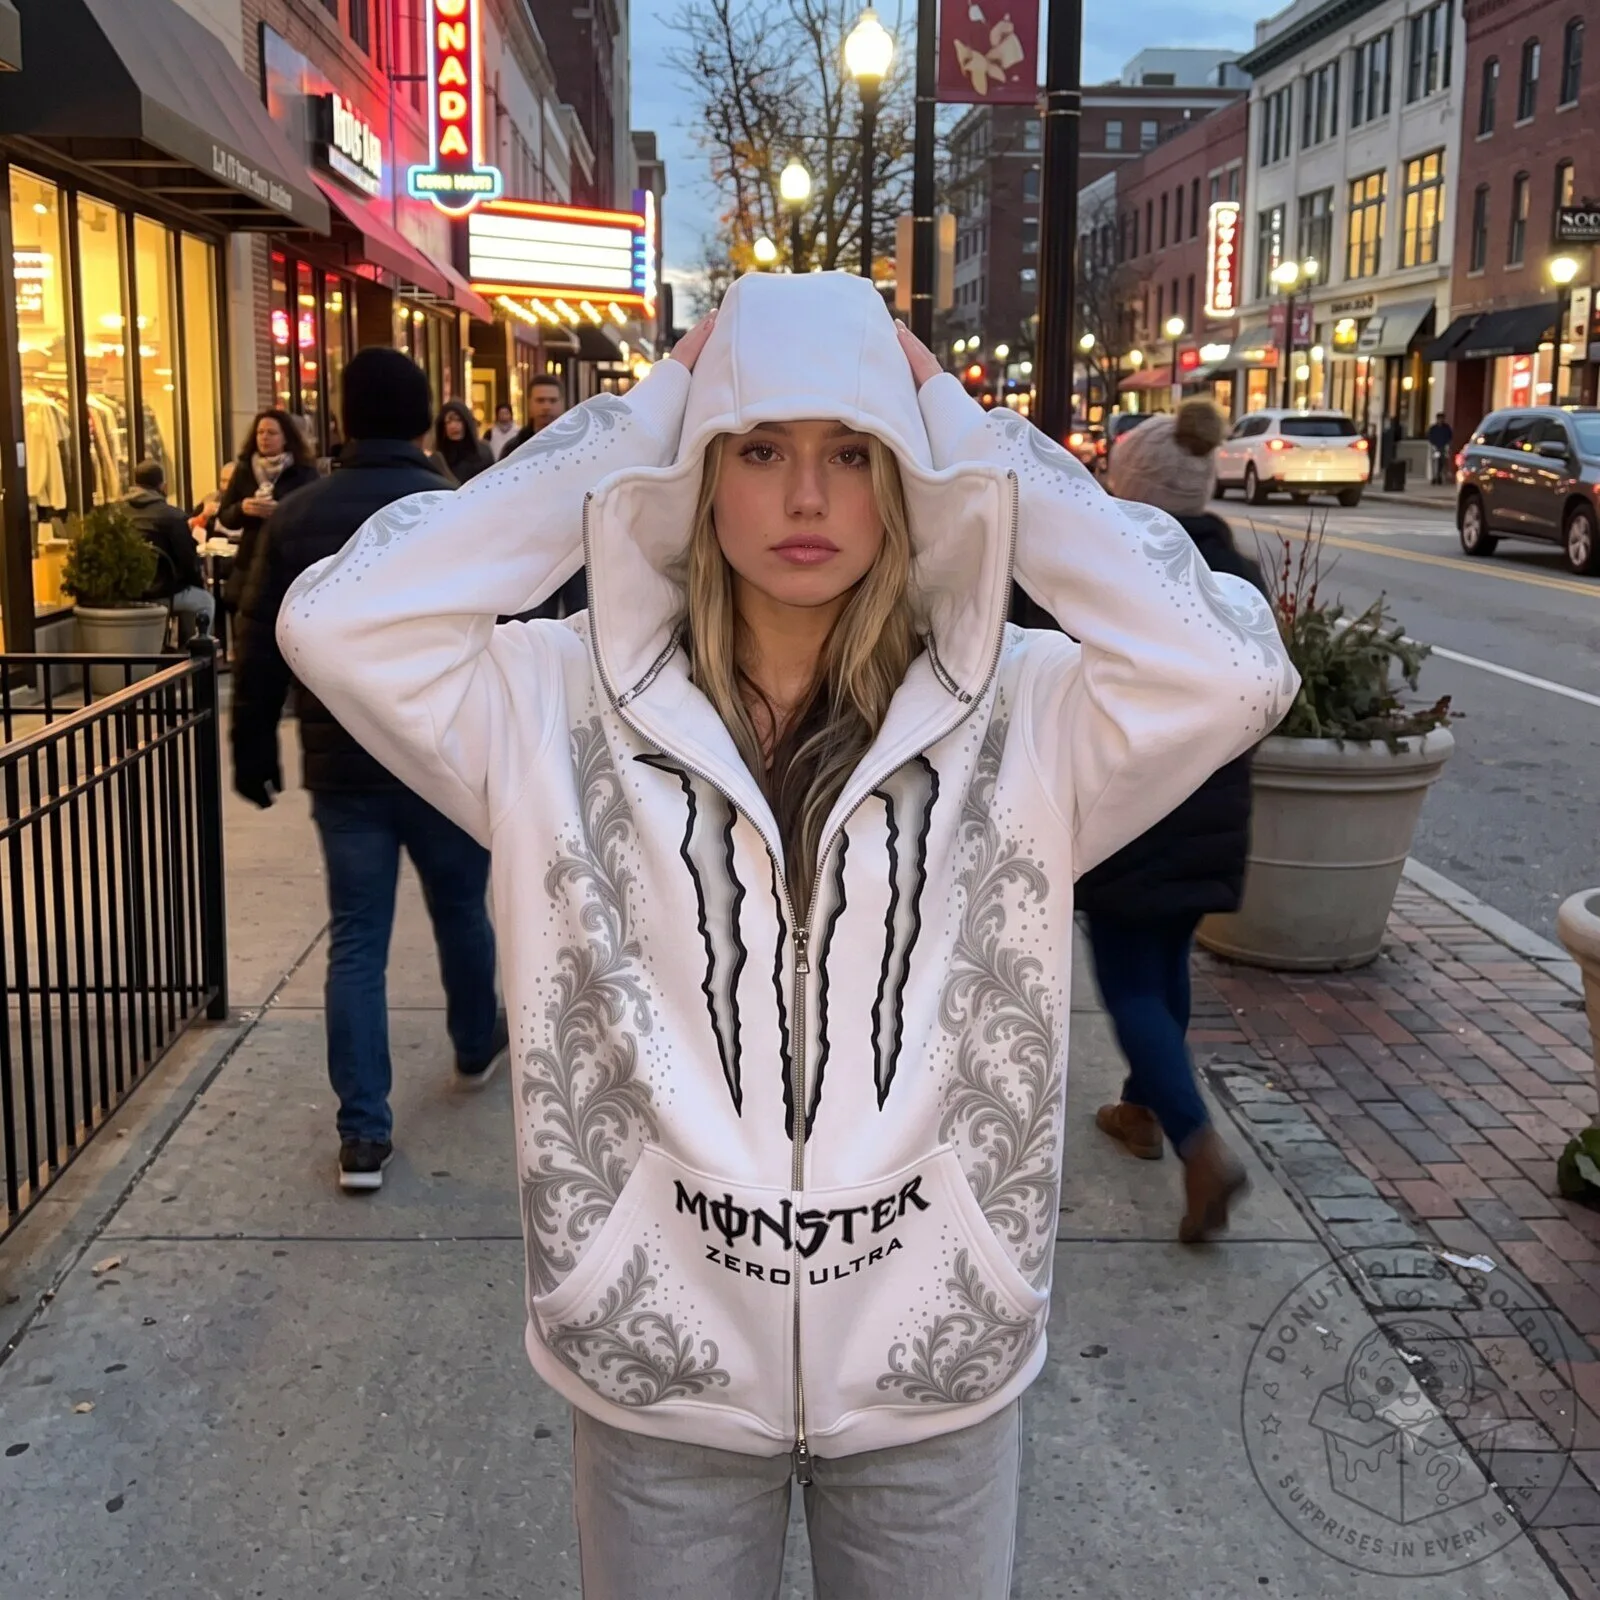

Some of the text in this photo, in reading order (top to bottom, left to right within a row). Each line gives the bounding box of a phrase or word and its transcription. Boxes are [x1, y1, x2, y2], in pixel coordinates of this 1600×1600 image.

[673, 1174, 931, 1260] MONSTER
[705, 1237, 904, 1286] ZERO ULTRA
